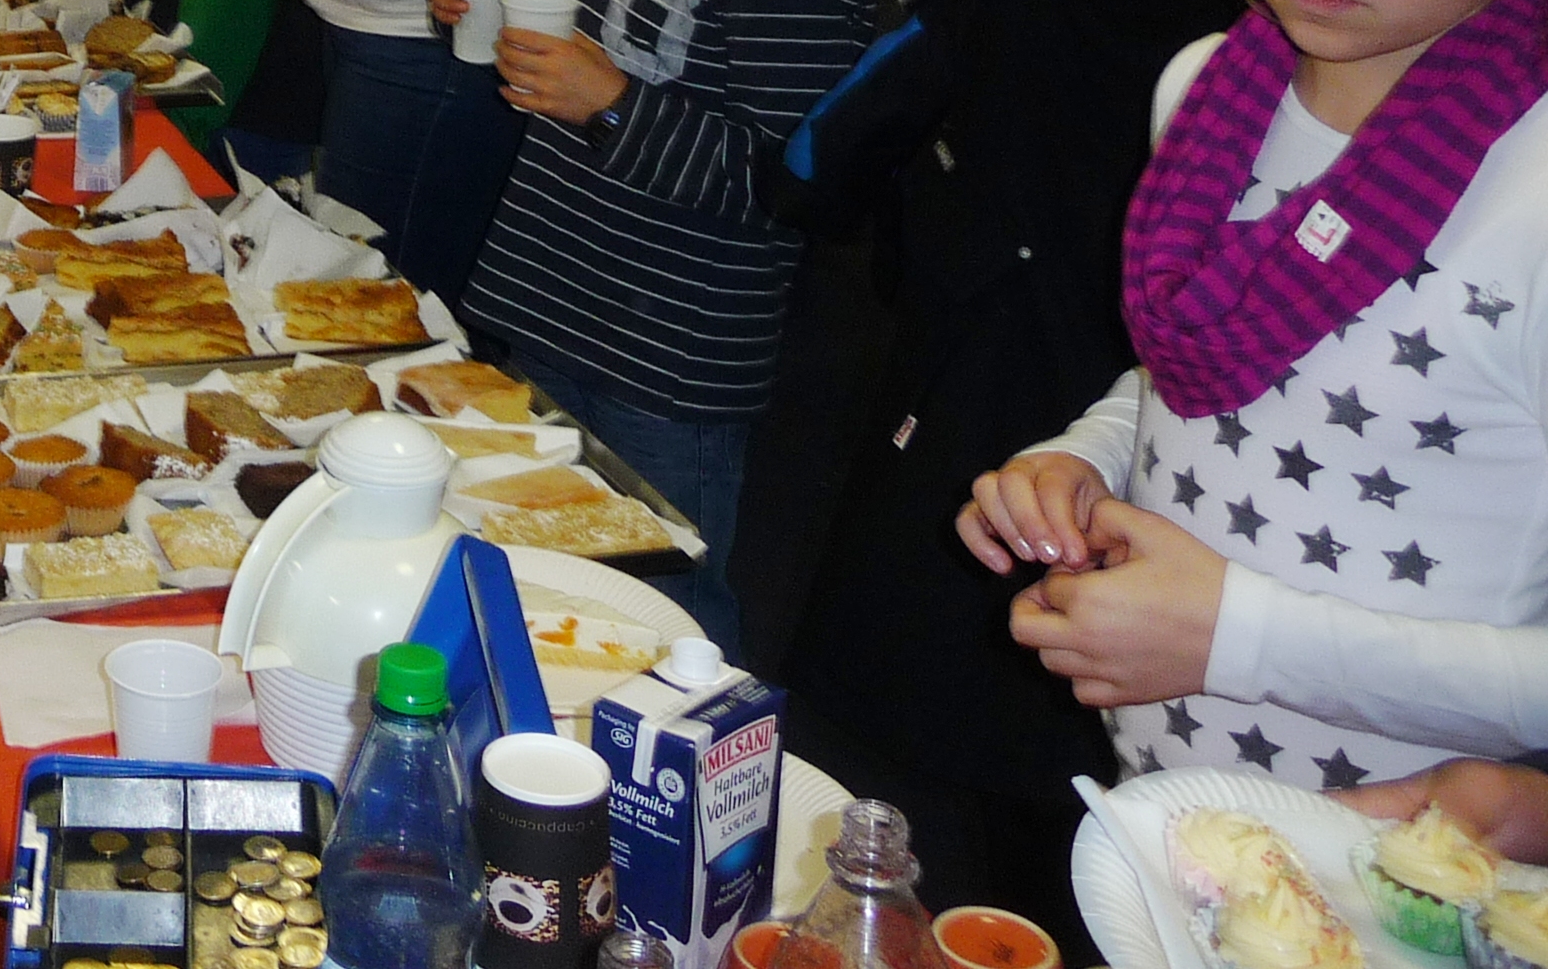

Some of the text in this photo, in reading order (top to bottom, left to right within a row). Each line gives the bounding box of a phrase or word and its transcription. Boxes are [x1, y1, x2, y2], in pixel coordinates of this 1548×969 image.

[614, 732, 630, 746] SIG
[708, 725, 769, 773] MILSANI
[714, 762, 762, 796] Haltbare
[611, 779, 675, 819] Vollmilch
[706, 771, 769, 824] Vollmilch
[498, 811, 585, 833] Cappuccino
[635, 809, 657, 827] Fett
[741, 808, 757, 830] Fett
